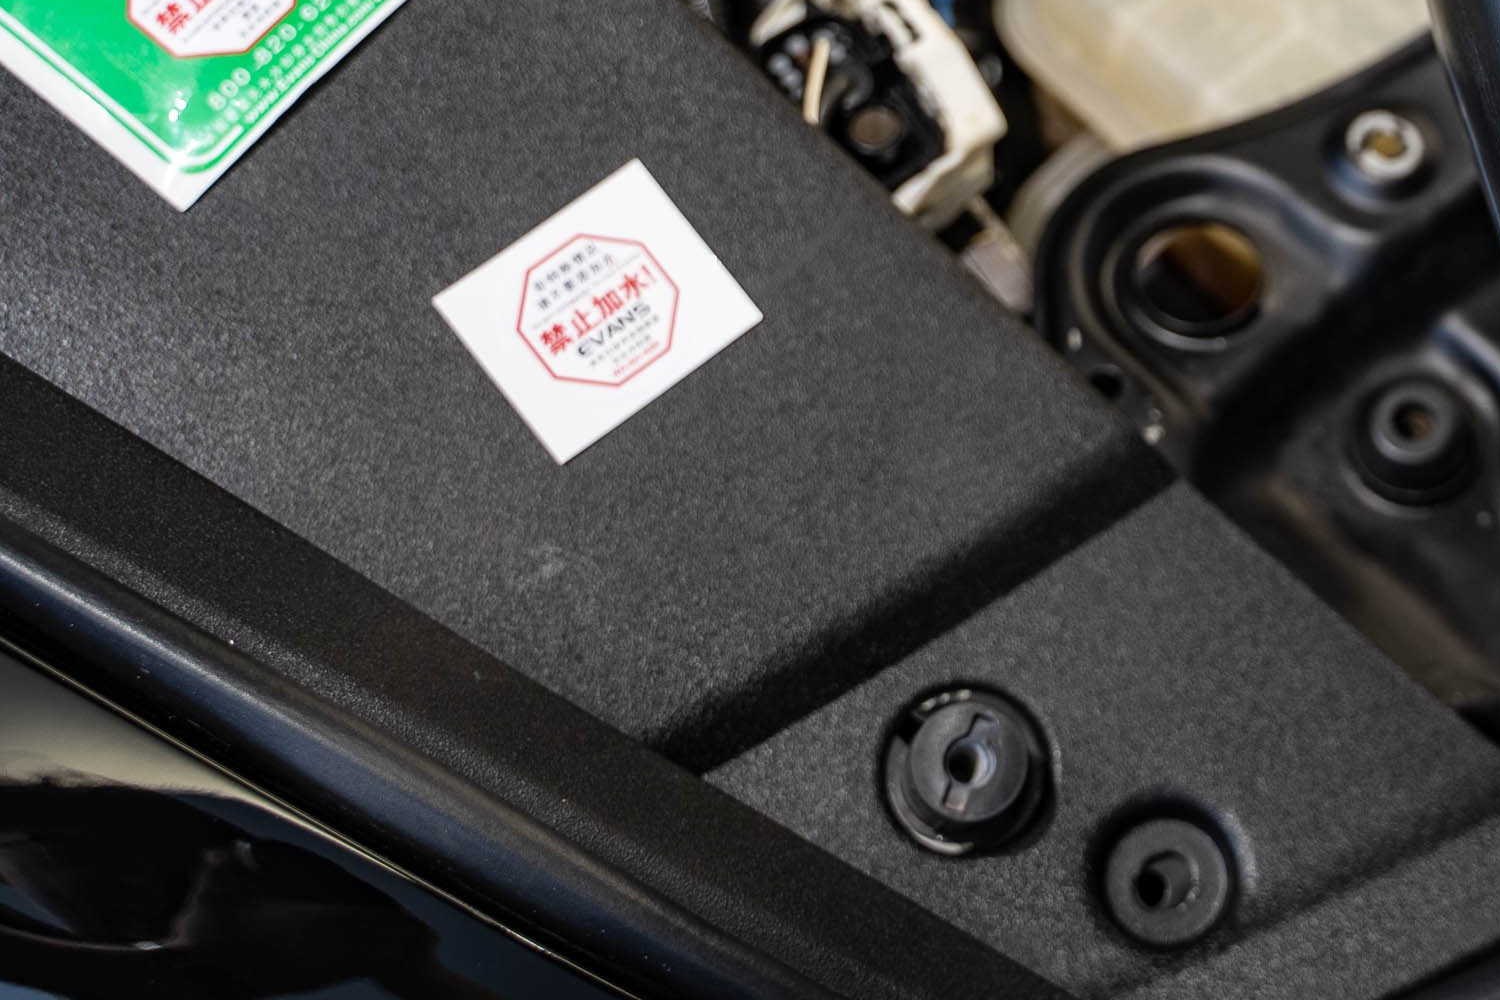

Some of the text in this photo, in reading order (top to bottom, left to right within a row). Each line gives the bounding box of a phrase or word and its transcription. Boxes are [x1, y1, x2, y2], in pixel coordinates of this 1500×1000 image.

[539, 264, 657, 355] 禁止加水!
[577, 301, 652, 358] EVANS
